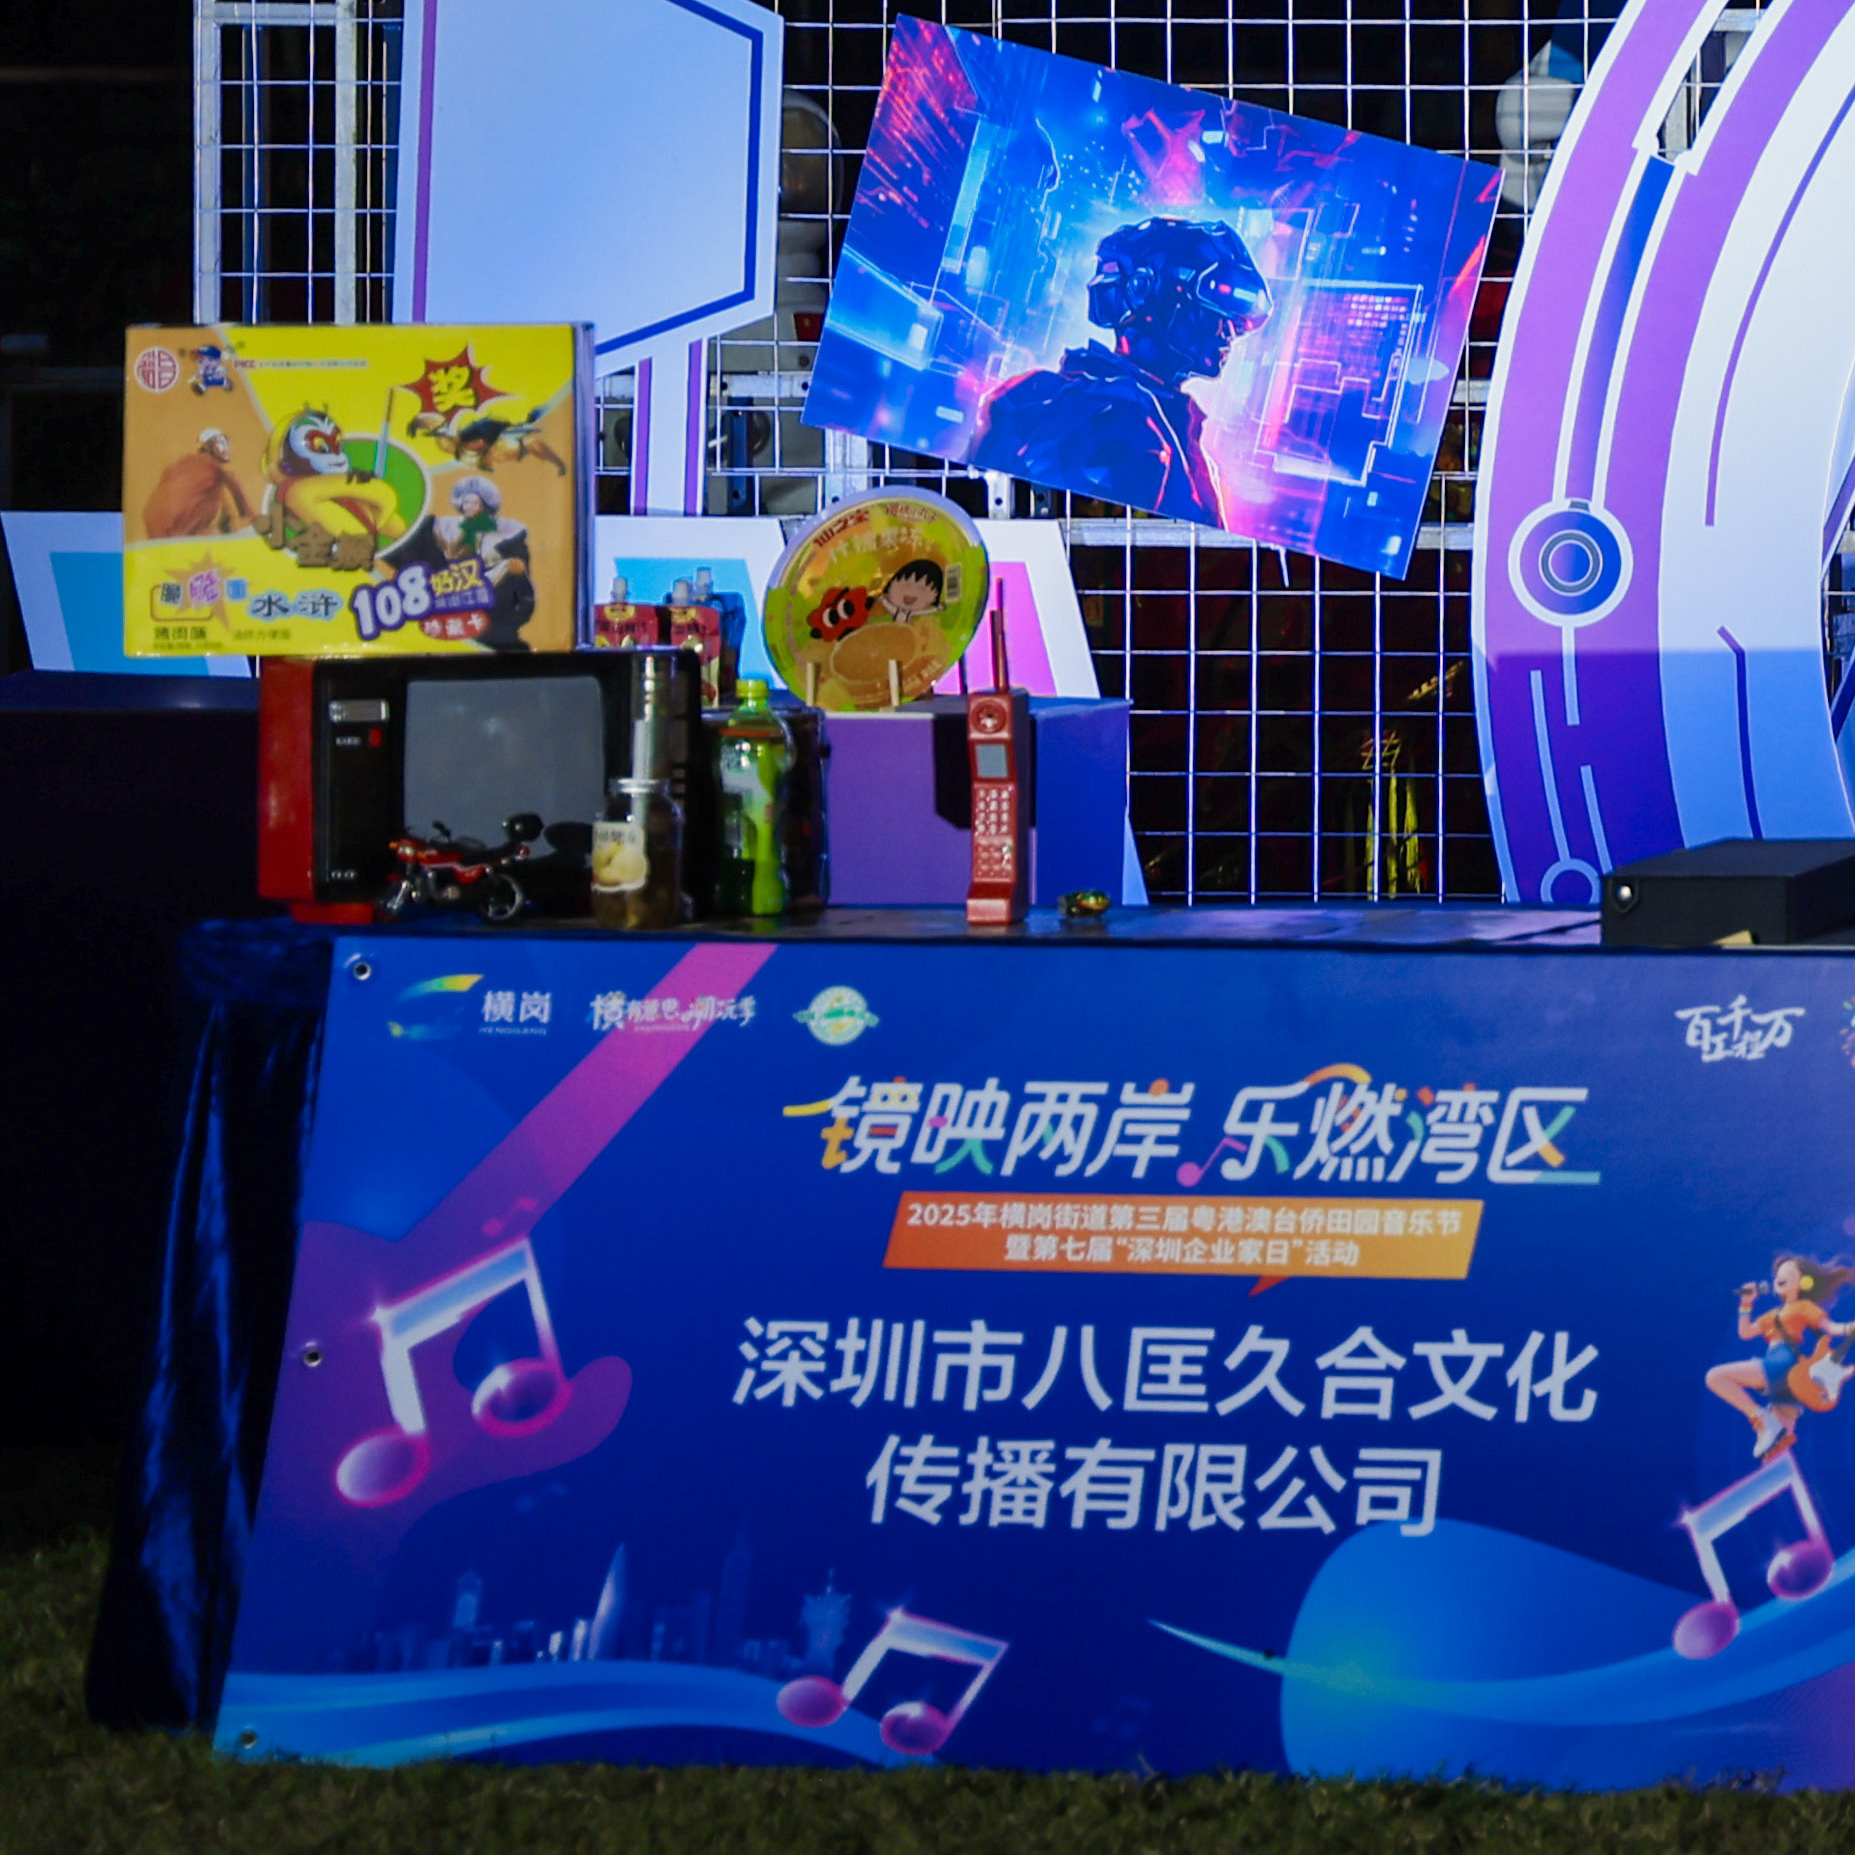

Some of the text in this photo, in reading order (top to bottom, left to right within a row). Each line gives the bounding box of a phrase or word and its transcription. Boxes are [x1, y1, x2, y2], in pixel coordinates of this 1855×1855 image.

[353, 565, 430, 637] 108
[481, 990, 552, 1024] 横岗
[784, 1063, 1601, 1187] 镜映两岸 乐燃湾区
[906, 1201, 1462, 1238] 2025年横岗街道第三届粤港澳台侨田园音乐节
[733, 1316, 1599, 1424] 深圳市八匡久合文化
[866, 1434, 1442, 1539] 传播有限公司
